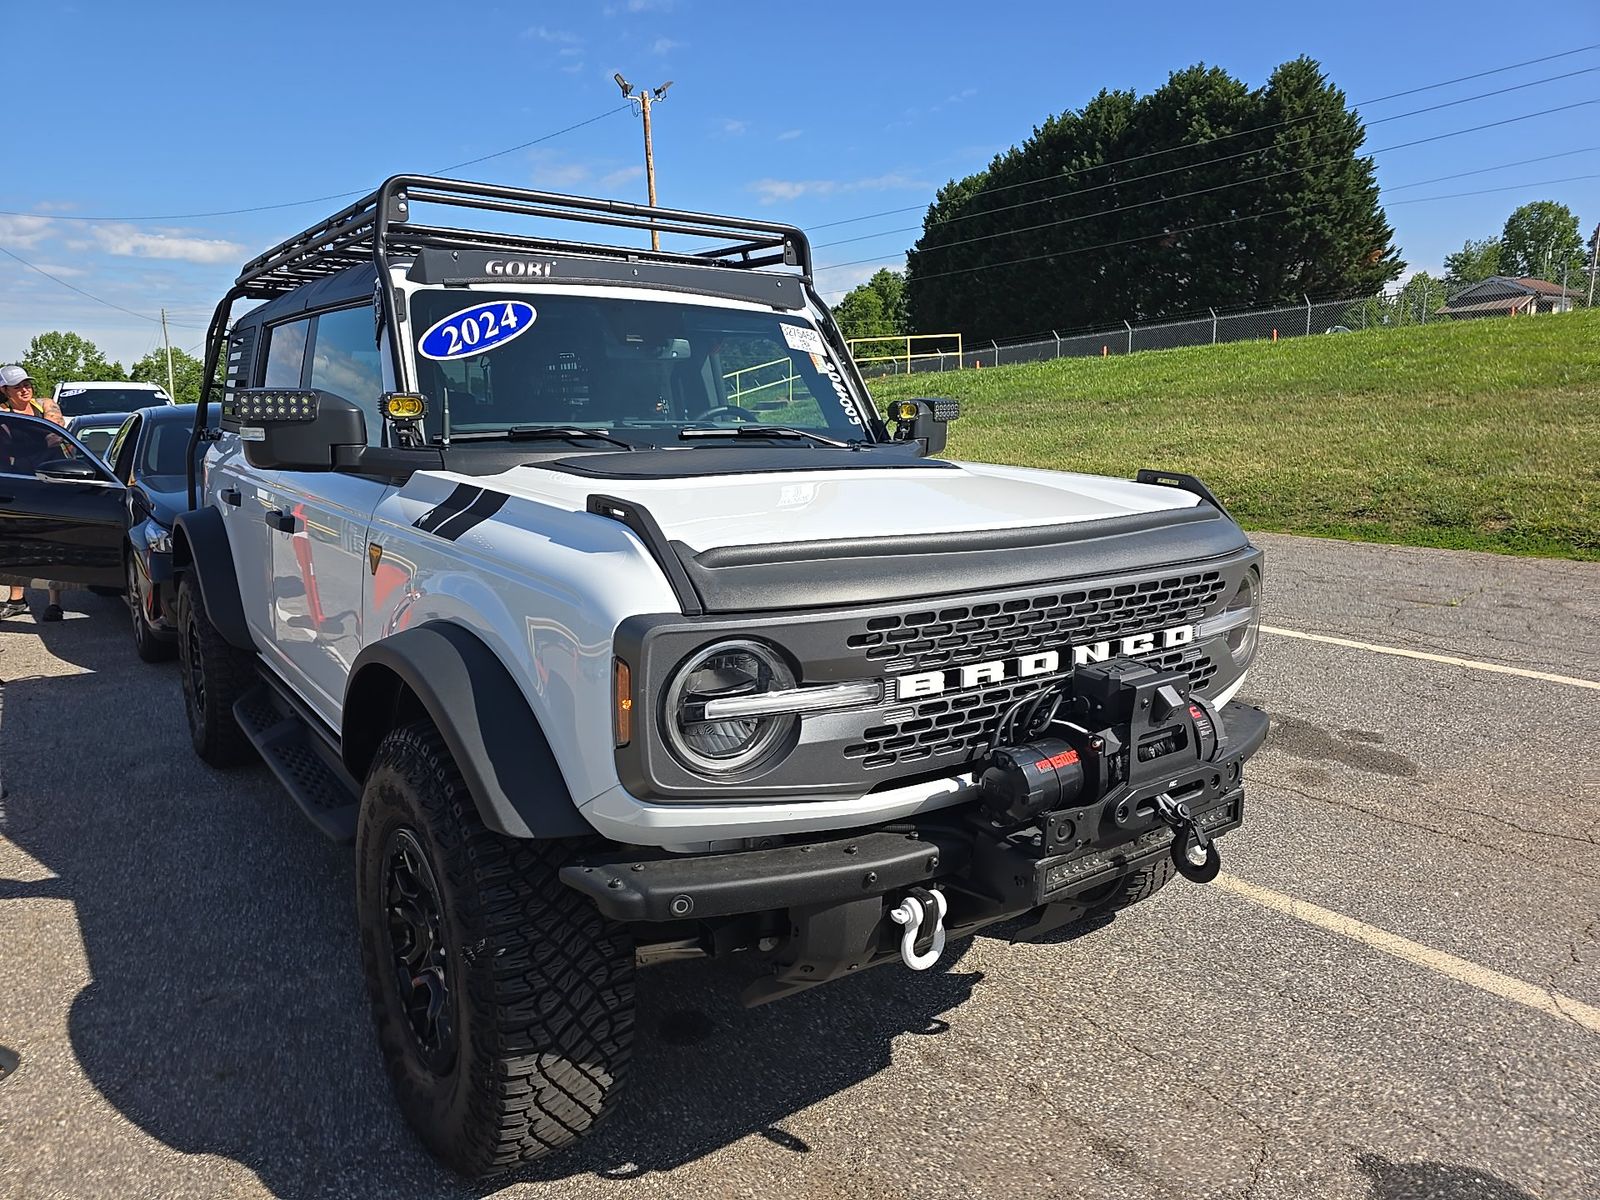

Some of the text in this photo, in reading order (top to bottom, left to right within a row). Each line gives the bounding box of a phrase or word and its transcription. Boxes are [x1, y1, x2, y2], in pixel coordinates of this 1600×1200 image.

[485, 260, 551, 278] GOBI
[441, 302, 519, 355] 2024
[895, 623, 1197, 700] BRONCO
